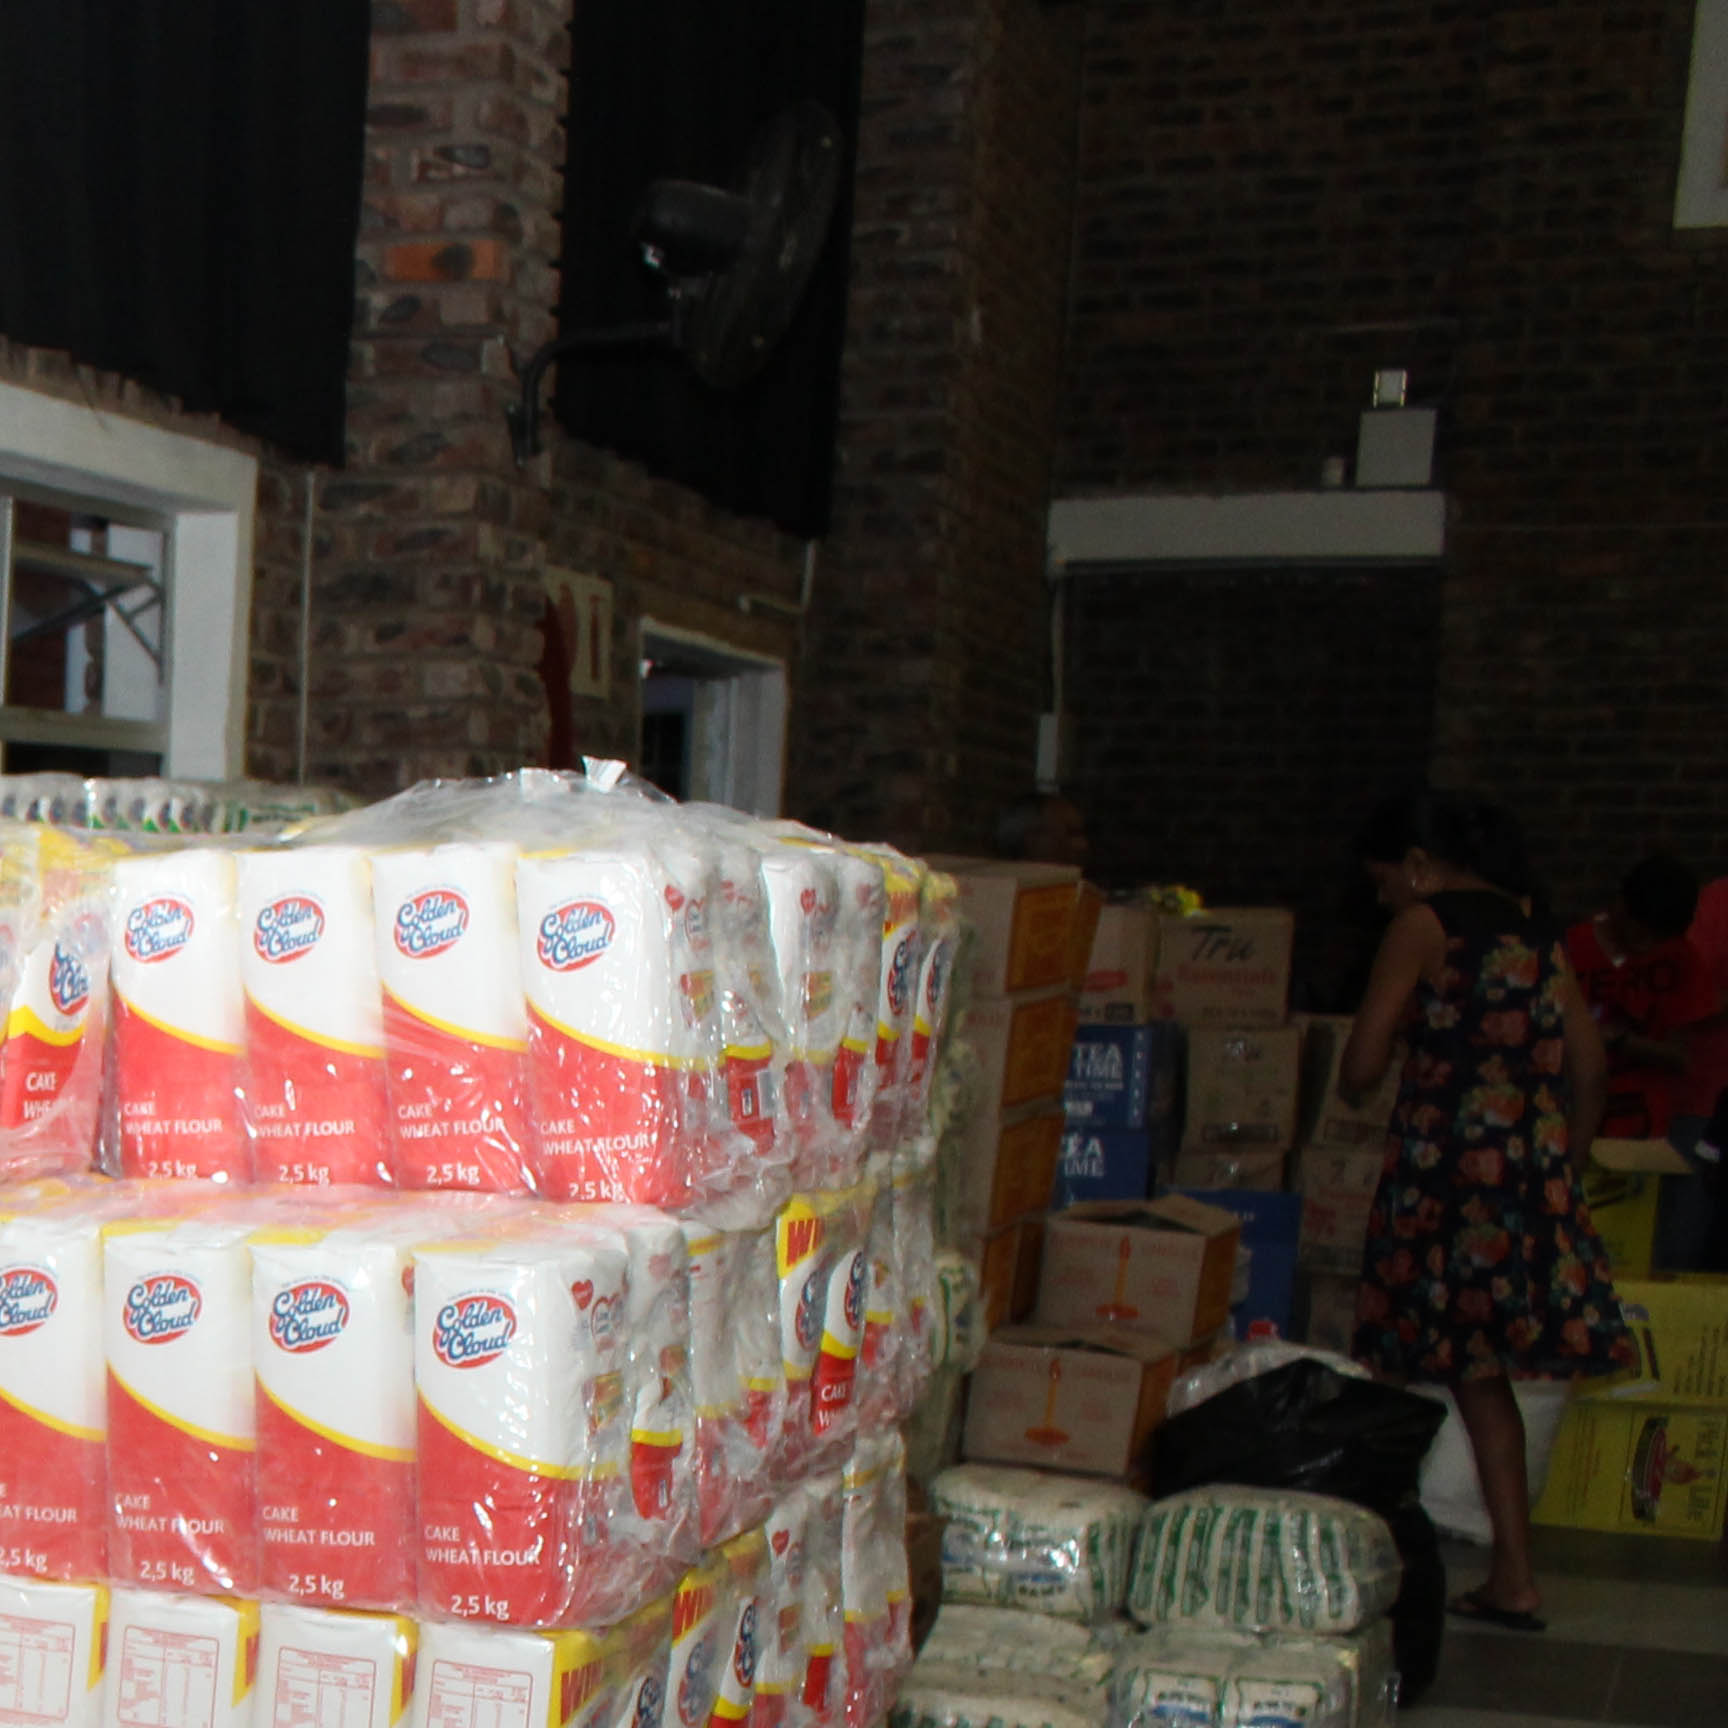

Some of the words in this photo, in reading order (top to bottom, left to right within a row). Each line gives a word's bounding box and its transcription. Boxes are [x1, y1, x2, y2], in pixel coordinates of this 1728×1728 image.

[256, 904, 313, 951] Golden
[397, 898, 459, 944] Golden
[540, 910, 603, 956] Golden
[138, 928, 189, 957] Cloud
[267, 927, 319, 957] Cloud
[409, 921, 465, 951] Cloud
[553, 933, 610, 964] Cloud
[1071, 1042, 1124, 1061] TEA
[26, 1071, 58, 1092] CAKE
[1071, 1060, 1124, 1080] TIME
[398, 1103, 433, 1120] CAKE
[174, 1118, 222, 1134] FLOUR
[305, 1120, 356, 1136] FLOUR
[454, 1118, 505, 1136] FLOUR
[540, 1119, 575, 1135] CAKE
[175, 1162, 197, 1181] kg
[306, 1165, 331, 1186] kg
[455, 1164, 481, 1185] kg
[128, 1283, 190, 1329] Golden
[272, 1291, 337, 1338] Golden
[139, 1305, 195, 1336] Cloud
[284, 1313, 345, 1345] Cloud
[435, 1305, 502, 1355] Golden
[448, 1328, 512, 1361] Cloud
[25, 1506, 78, 1525] FLOUR
[263, 1505, 299, 1524] CAKE
[264, 1526, 316, 1546] WHEAT
[320, 1529, 376, 1548] FLOUR
[425, 1524, 461, 1543] CAKE
[22, 1551, 48, 1575] kg
[426, 1547, 481, 1565] WHEAT
[169, 1563, 196, 1587] kg
[319, 1576, 345, 1601] kg
[483, 1596, 510, 1621] kg
